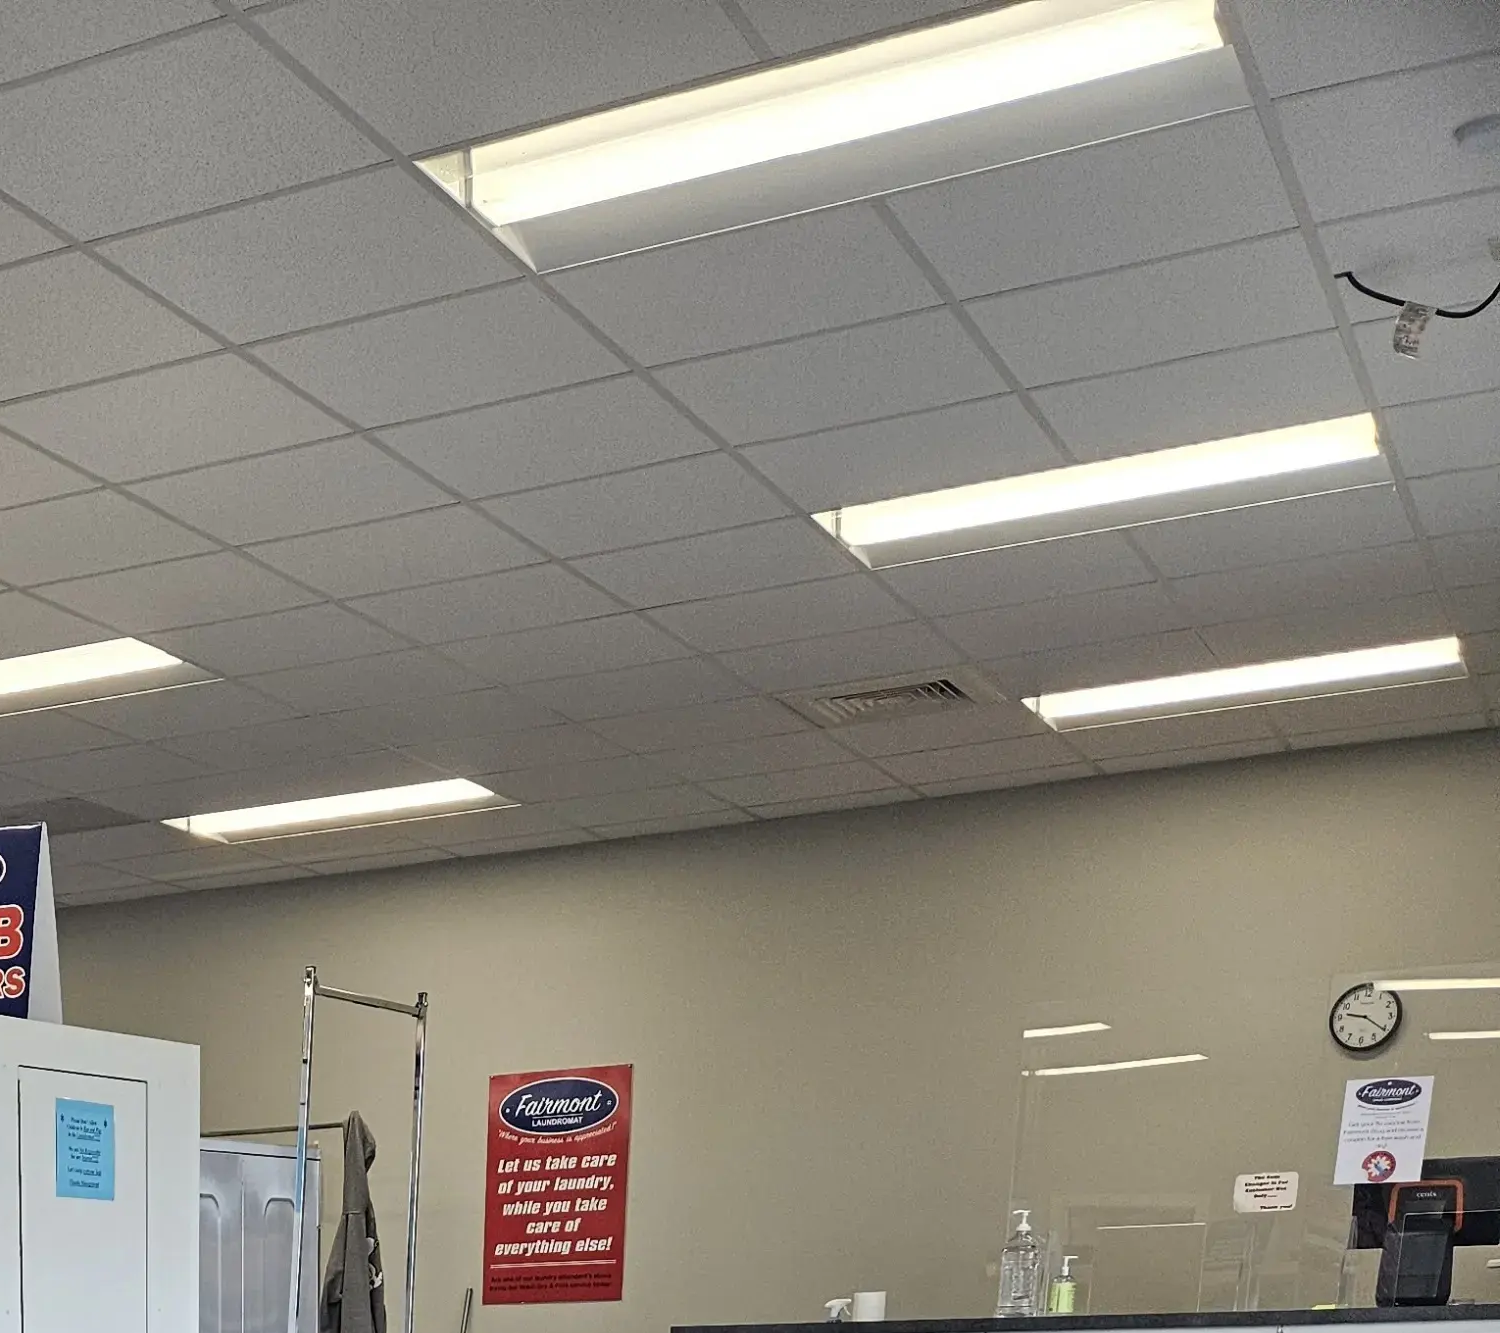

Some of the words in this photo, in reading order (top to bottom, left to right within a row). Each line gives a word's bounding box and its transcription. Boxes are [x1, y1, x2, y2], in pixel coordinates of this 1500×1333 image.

[1385, 1000, 1392, 1009] 2
[1361, 1084, 1416, 1098] Fairmont
[515, 1089, 602, 1118] Fairmont
[531, 1116, 583, 1127] LAUNDROMAT
[497, 1157, 520, 1174] Let
[523, 1159, 541, 1172] us
[545, 1154, 577, 1171] take
[581, 1154, 617, 1169] care
[498, 1179, 513, 1195] of
[514, 1179, 551, 1196] your
[553, 1174, 615, 1192] laundry,
[502, 1199, 541, 1216] while
[544, 1200, 571, 1216] you
[575, 1197, 608, 1212] take
[526, 1220, 561, 1235] care
[564, 1217, 582, 1233] of
[494, 1238, 572, 1257] everything
[575, 1236, 613, 1252] else!
